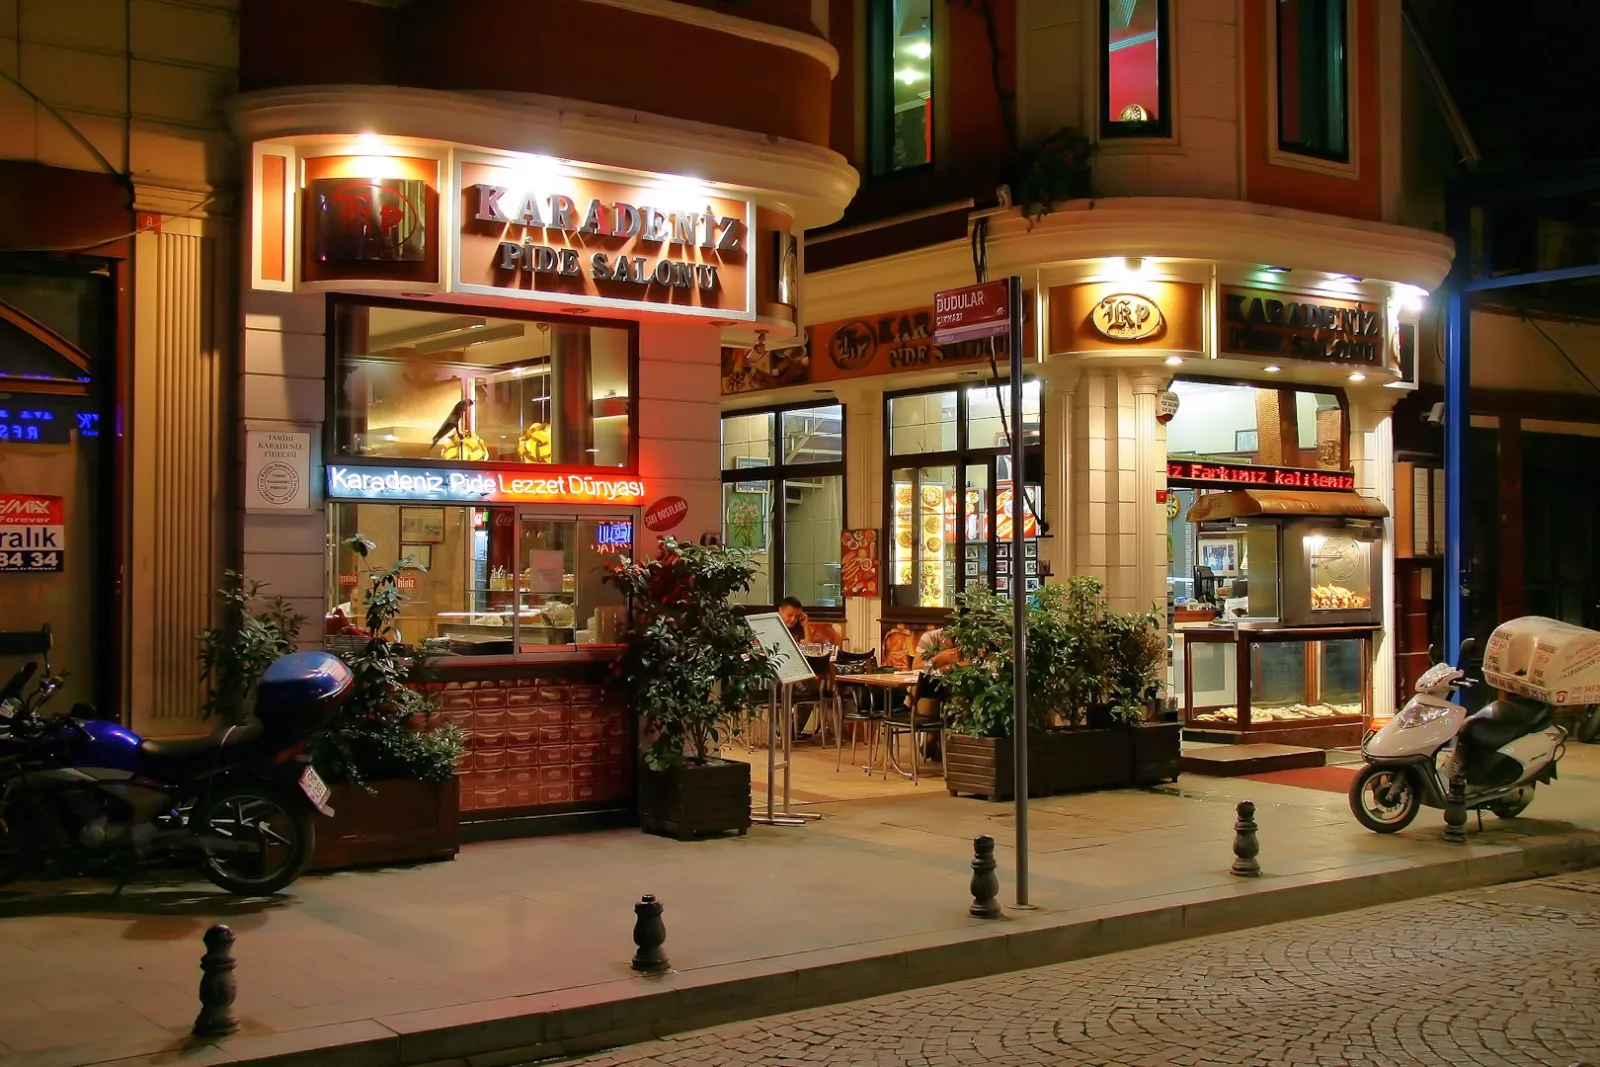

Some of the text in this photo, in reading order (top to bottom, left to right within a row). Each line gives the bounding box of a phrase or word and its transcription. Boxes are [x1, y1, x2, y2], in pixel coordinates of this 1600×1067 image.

[475, 184, 741, 251] KARADENİZ
[500, 236, 718, 291] PİDE SALONU
[937, 290, 985, 313] DUDULAR
[330, 466, 645, 501] Karadeniz Pide Lezzet Dünyası
[30, 552, 58, 567] 34
